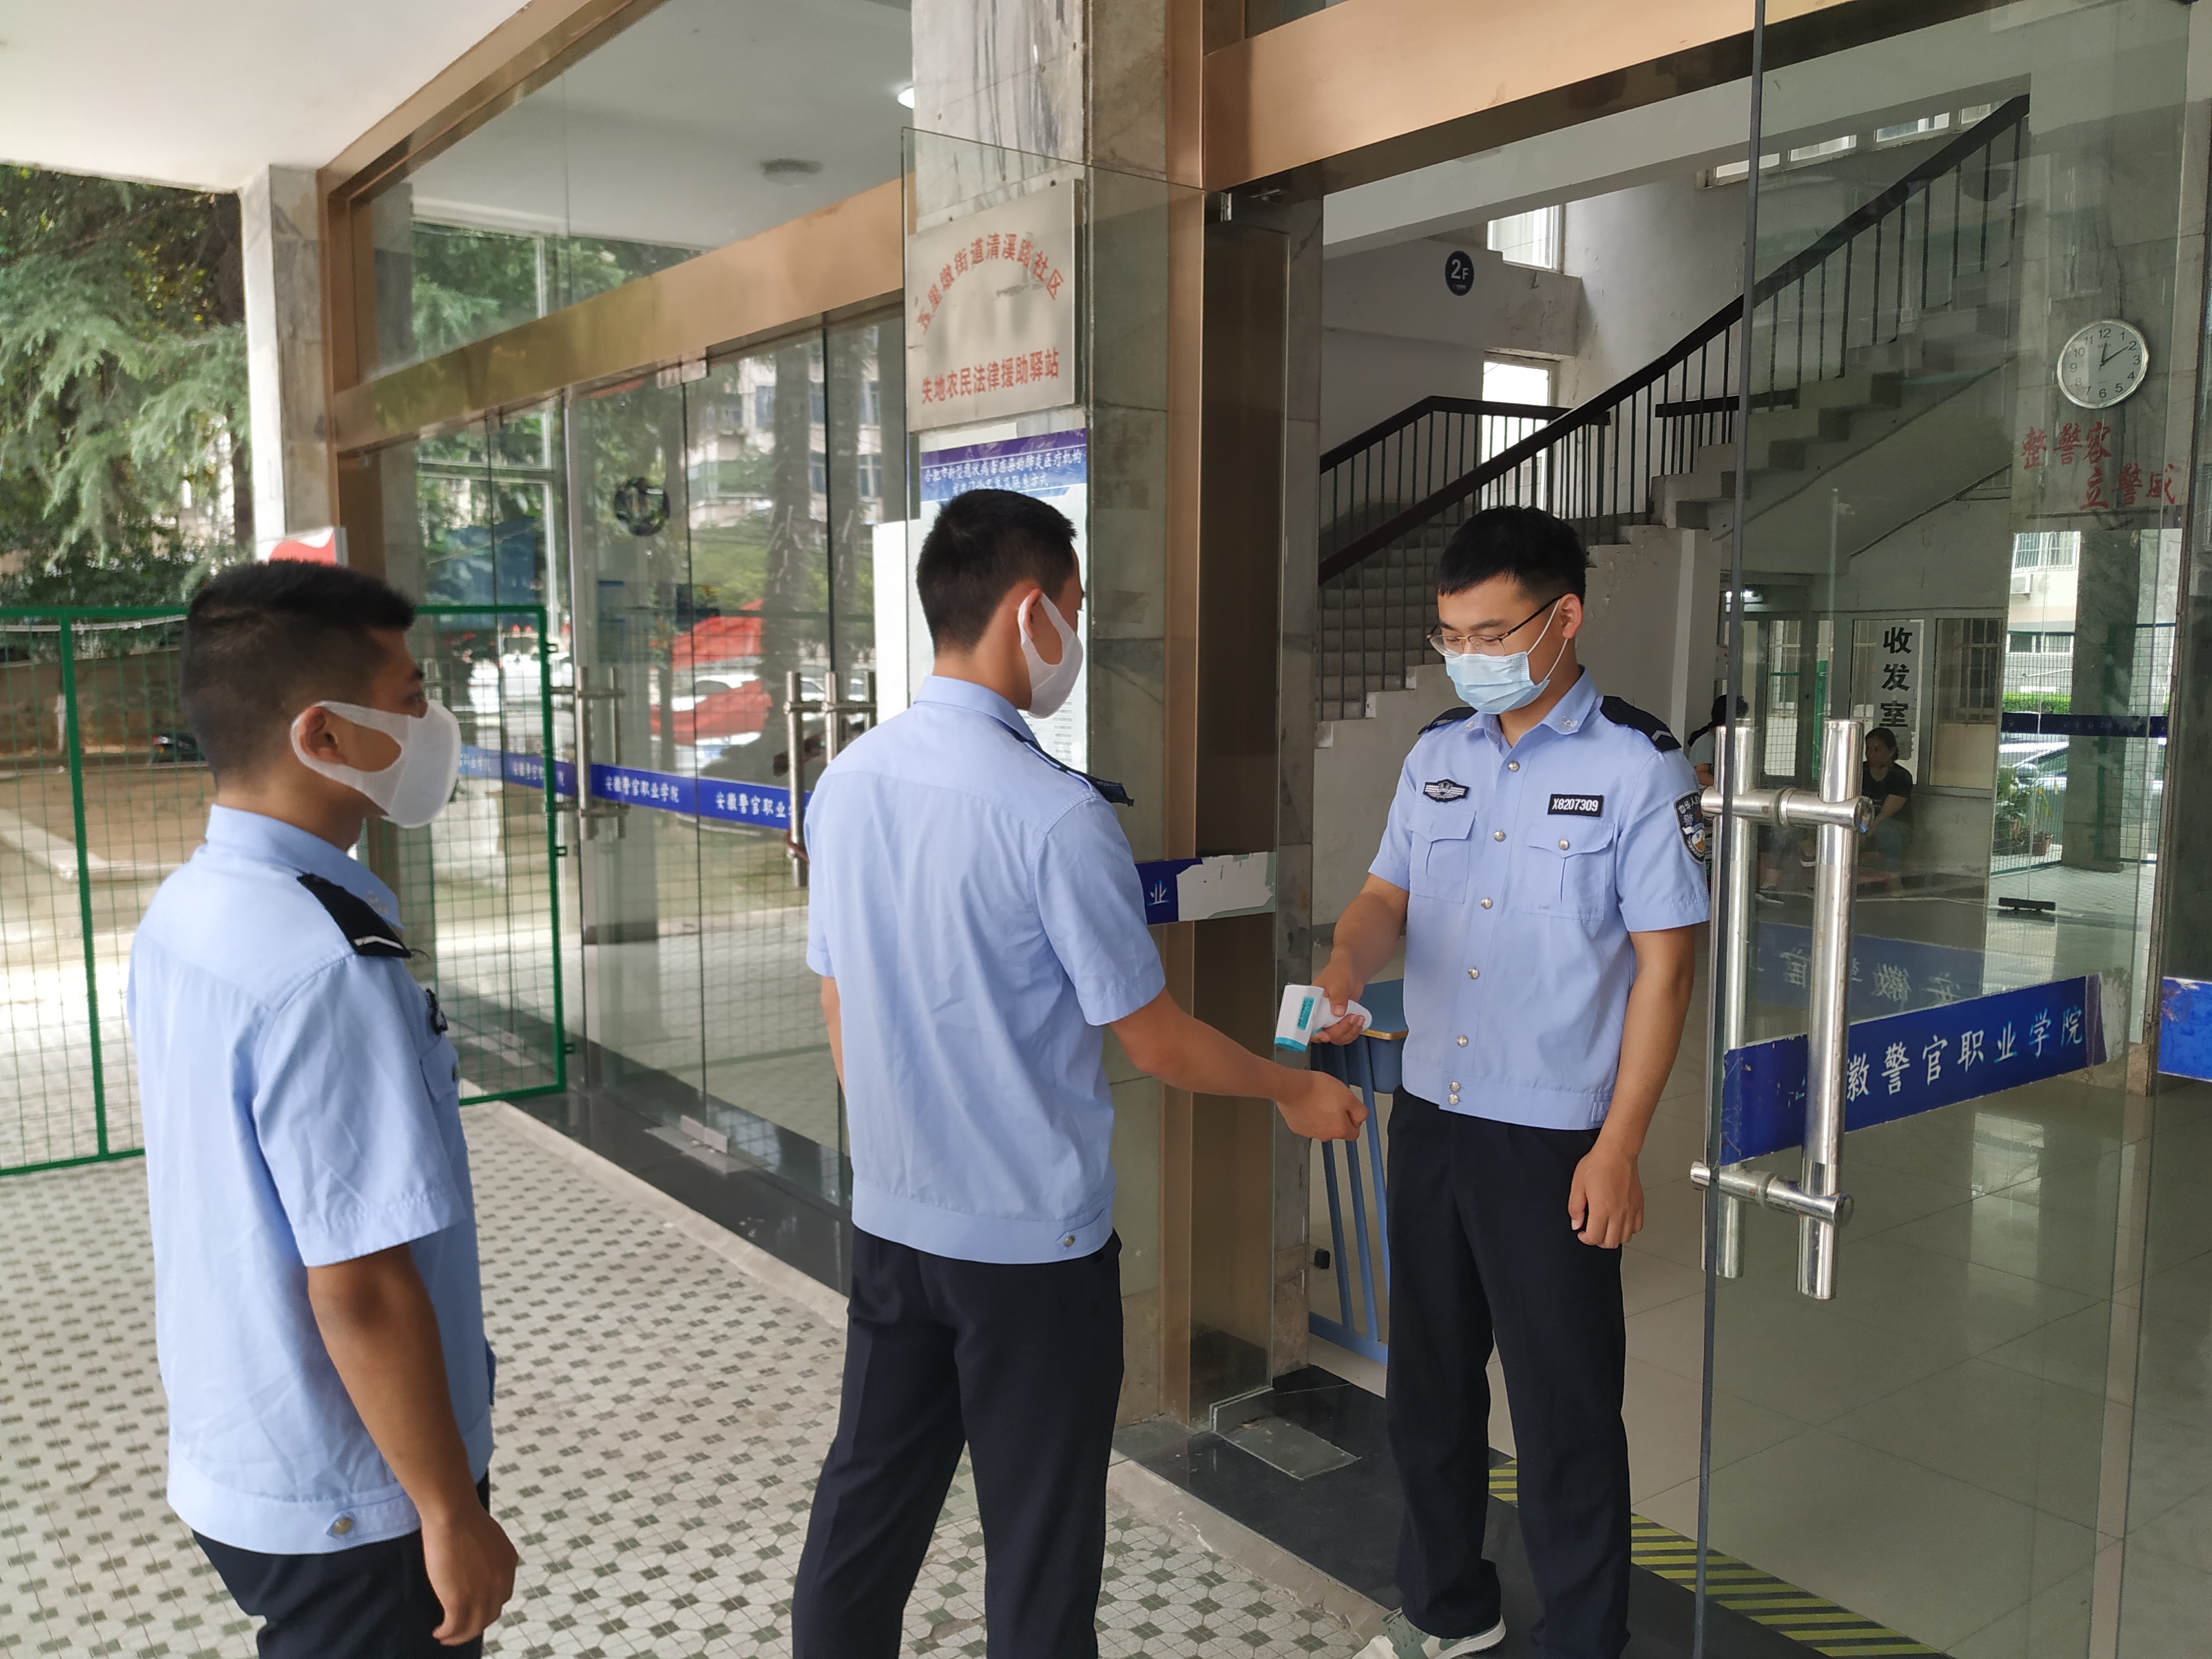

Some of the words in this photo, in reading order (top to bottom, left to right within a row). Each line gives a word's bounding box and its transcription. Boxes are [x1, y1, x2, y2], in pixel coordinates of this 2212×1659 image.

[1451, 258, 1469, 280] 2F
[2099, 328, 2111, 338] 12
[2121, 331, 2125, 341] 1
[2084, 335, 2093, 345] 11
[2129, 341, 2137, 350] 2
[2074, 347, 2085, 357] 10
[2133, 355, 2141, 365] 3
[2070, 363, 2078, 372] 9
[921, 347, 1059, 404] 失地农民法律援助驿站
[2127, 372, 2135, 380] 4
[2075, 378, 2082, 387] 8
[2087, 386, 2091, 395] 7
[2115, 383, 2123, 393] 5
[2099, 389, 2106, 398] 6
[2079, 462, 2175, 511] 立警威
[1879, 626, 1913, 728] 收发室
[715, 790, 792, 818] 安徽警官职业
[1551, 797, 1599, 812] X8207309
[1148, 880, 1170, 906] 业
[1795, 1005, 2083, 1103] 徽警官职业学院
